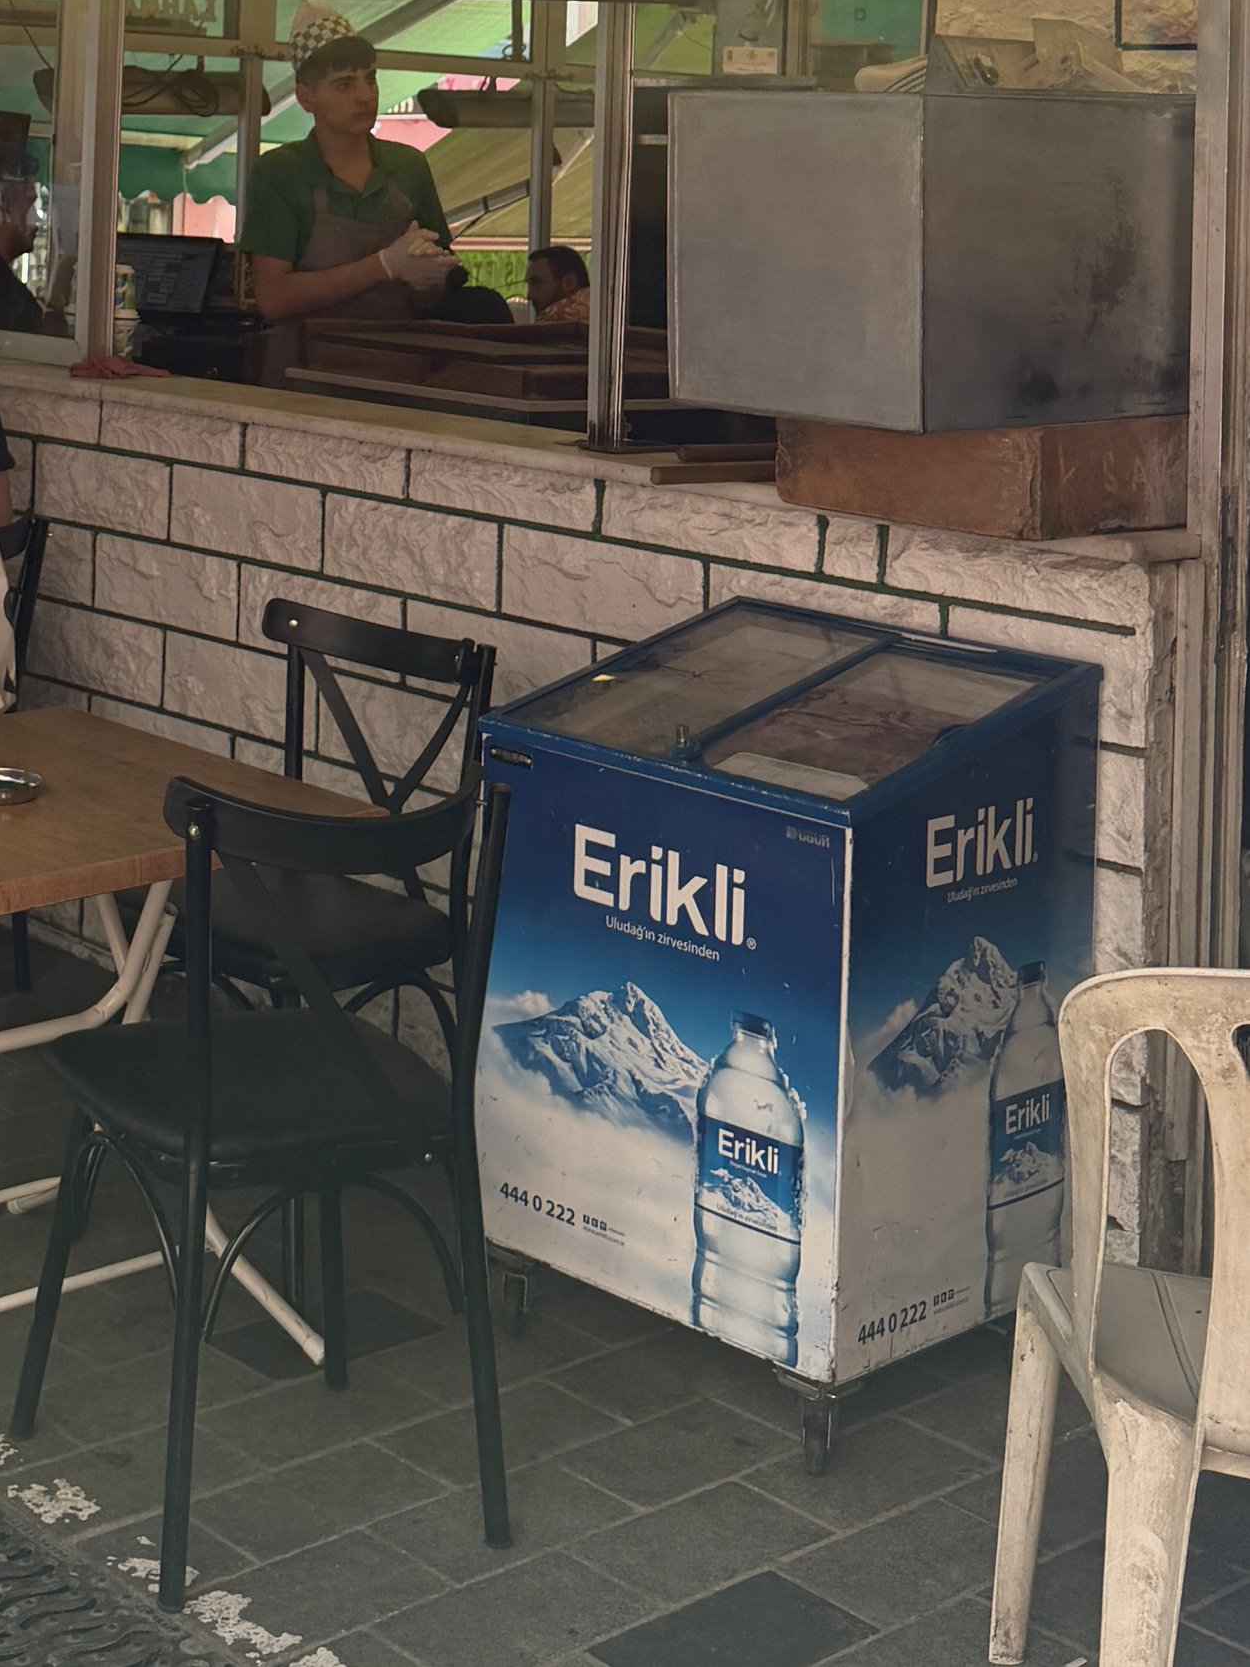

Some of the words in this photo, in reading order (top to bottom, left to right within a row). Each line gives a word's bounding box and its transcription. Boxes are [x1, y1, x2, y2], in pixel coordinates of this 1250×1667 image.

[926, 797, 1034, 888] Erikli
[573, 823, 746, 946] Erikli
[657, 933, 720, 961] zirvesinden
[1005, 1093, 1050, 1135] Erikli
[718, 1127, 779, 1174] Erikli
[499, 1182, 529, 1207] 444
[532, 1194, 543, 1212] 0
[545, 1199, 576, 1226] 222
[857, 1317, 886, 1346] 444
[888, 1312, 897, 1333] 0
[900, 1300, 927, 1328] 222
